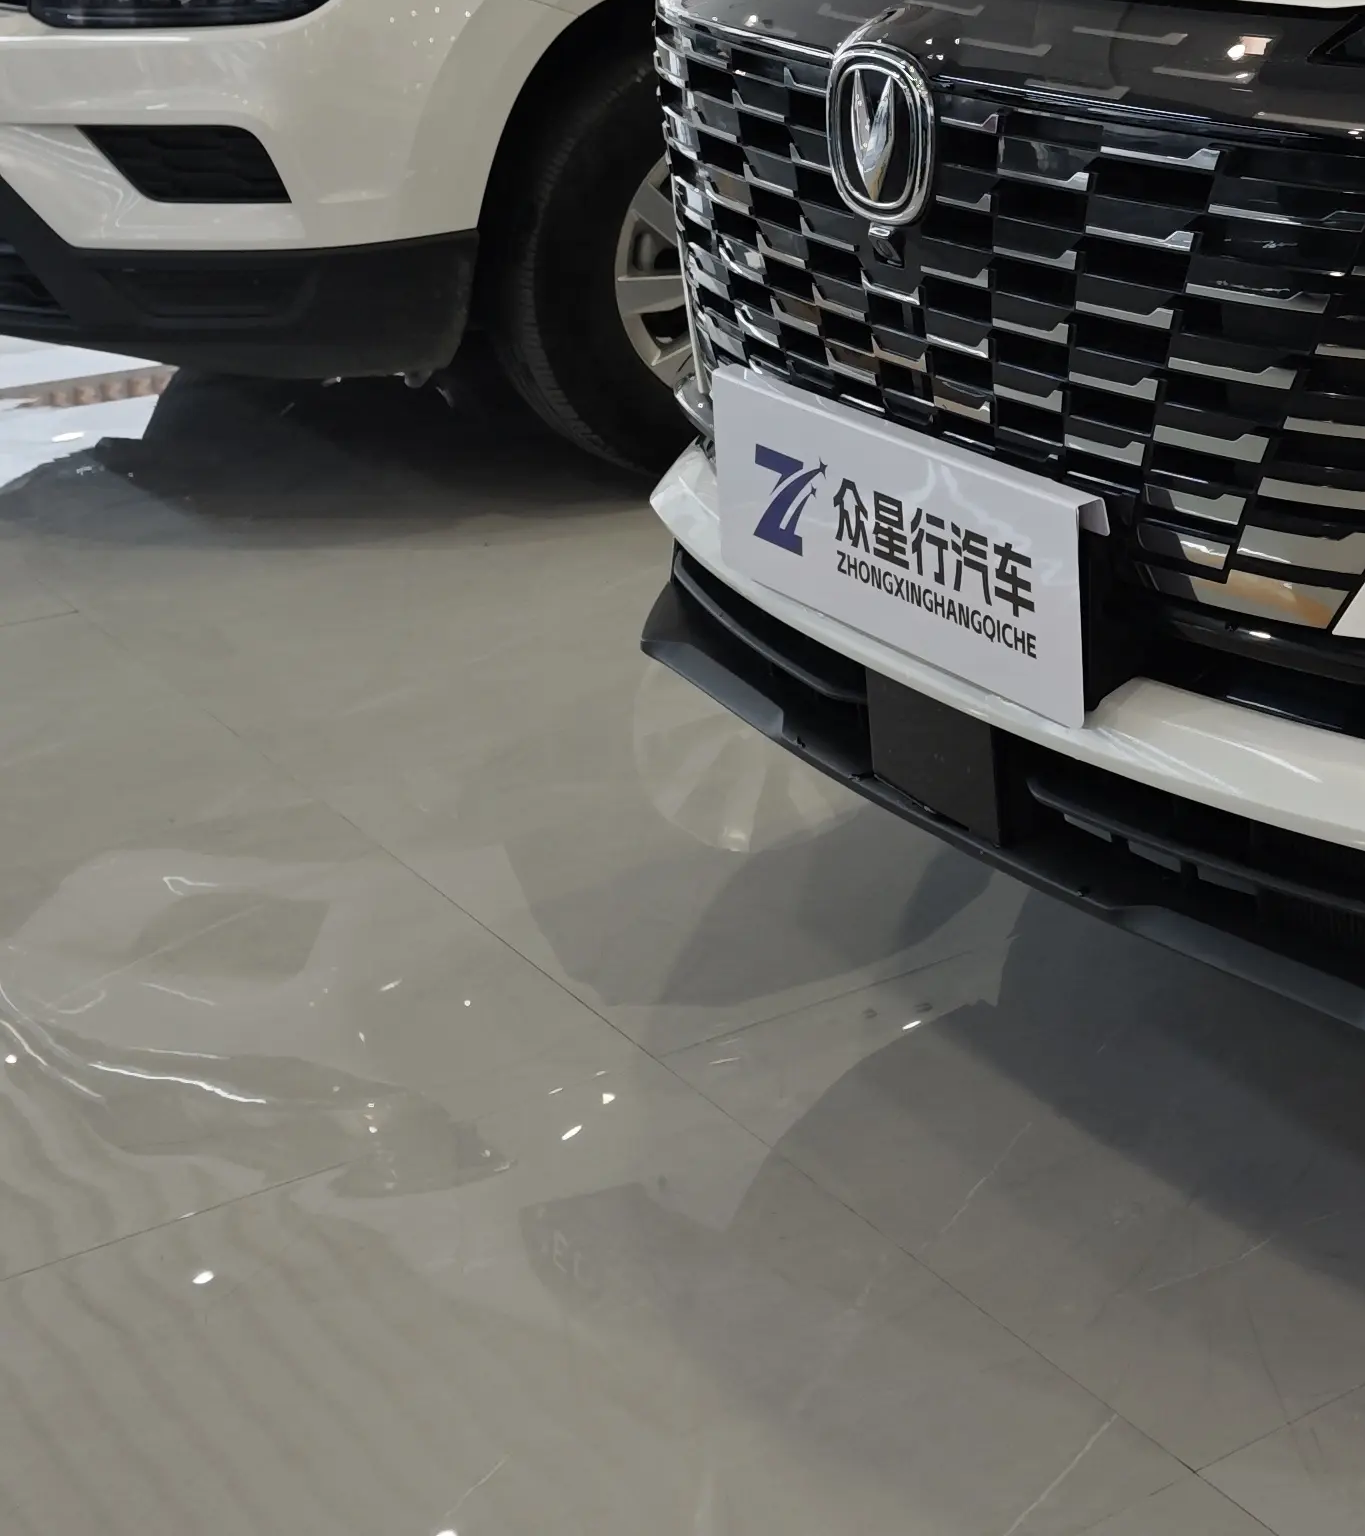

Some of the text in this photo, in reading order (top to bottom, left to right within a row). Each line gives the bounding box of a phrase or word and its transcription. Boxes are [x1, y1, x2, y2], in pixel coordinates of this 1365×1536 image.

[833, 477, 1036, 618] 众星行汽车
[836, 549, 1038, 660] ZHONGXINGHANGQICHE
